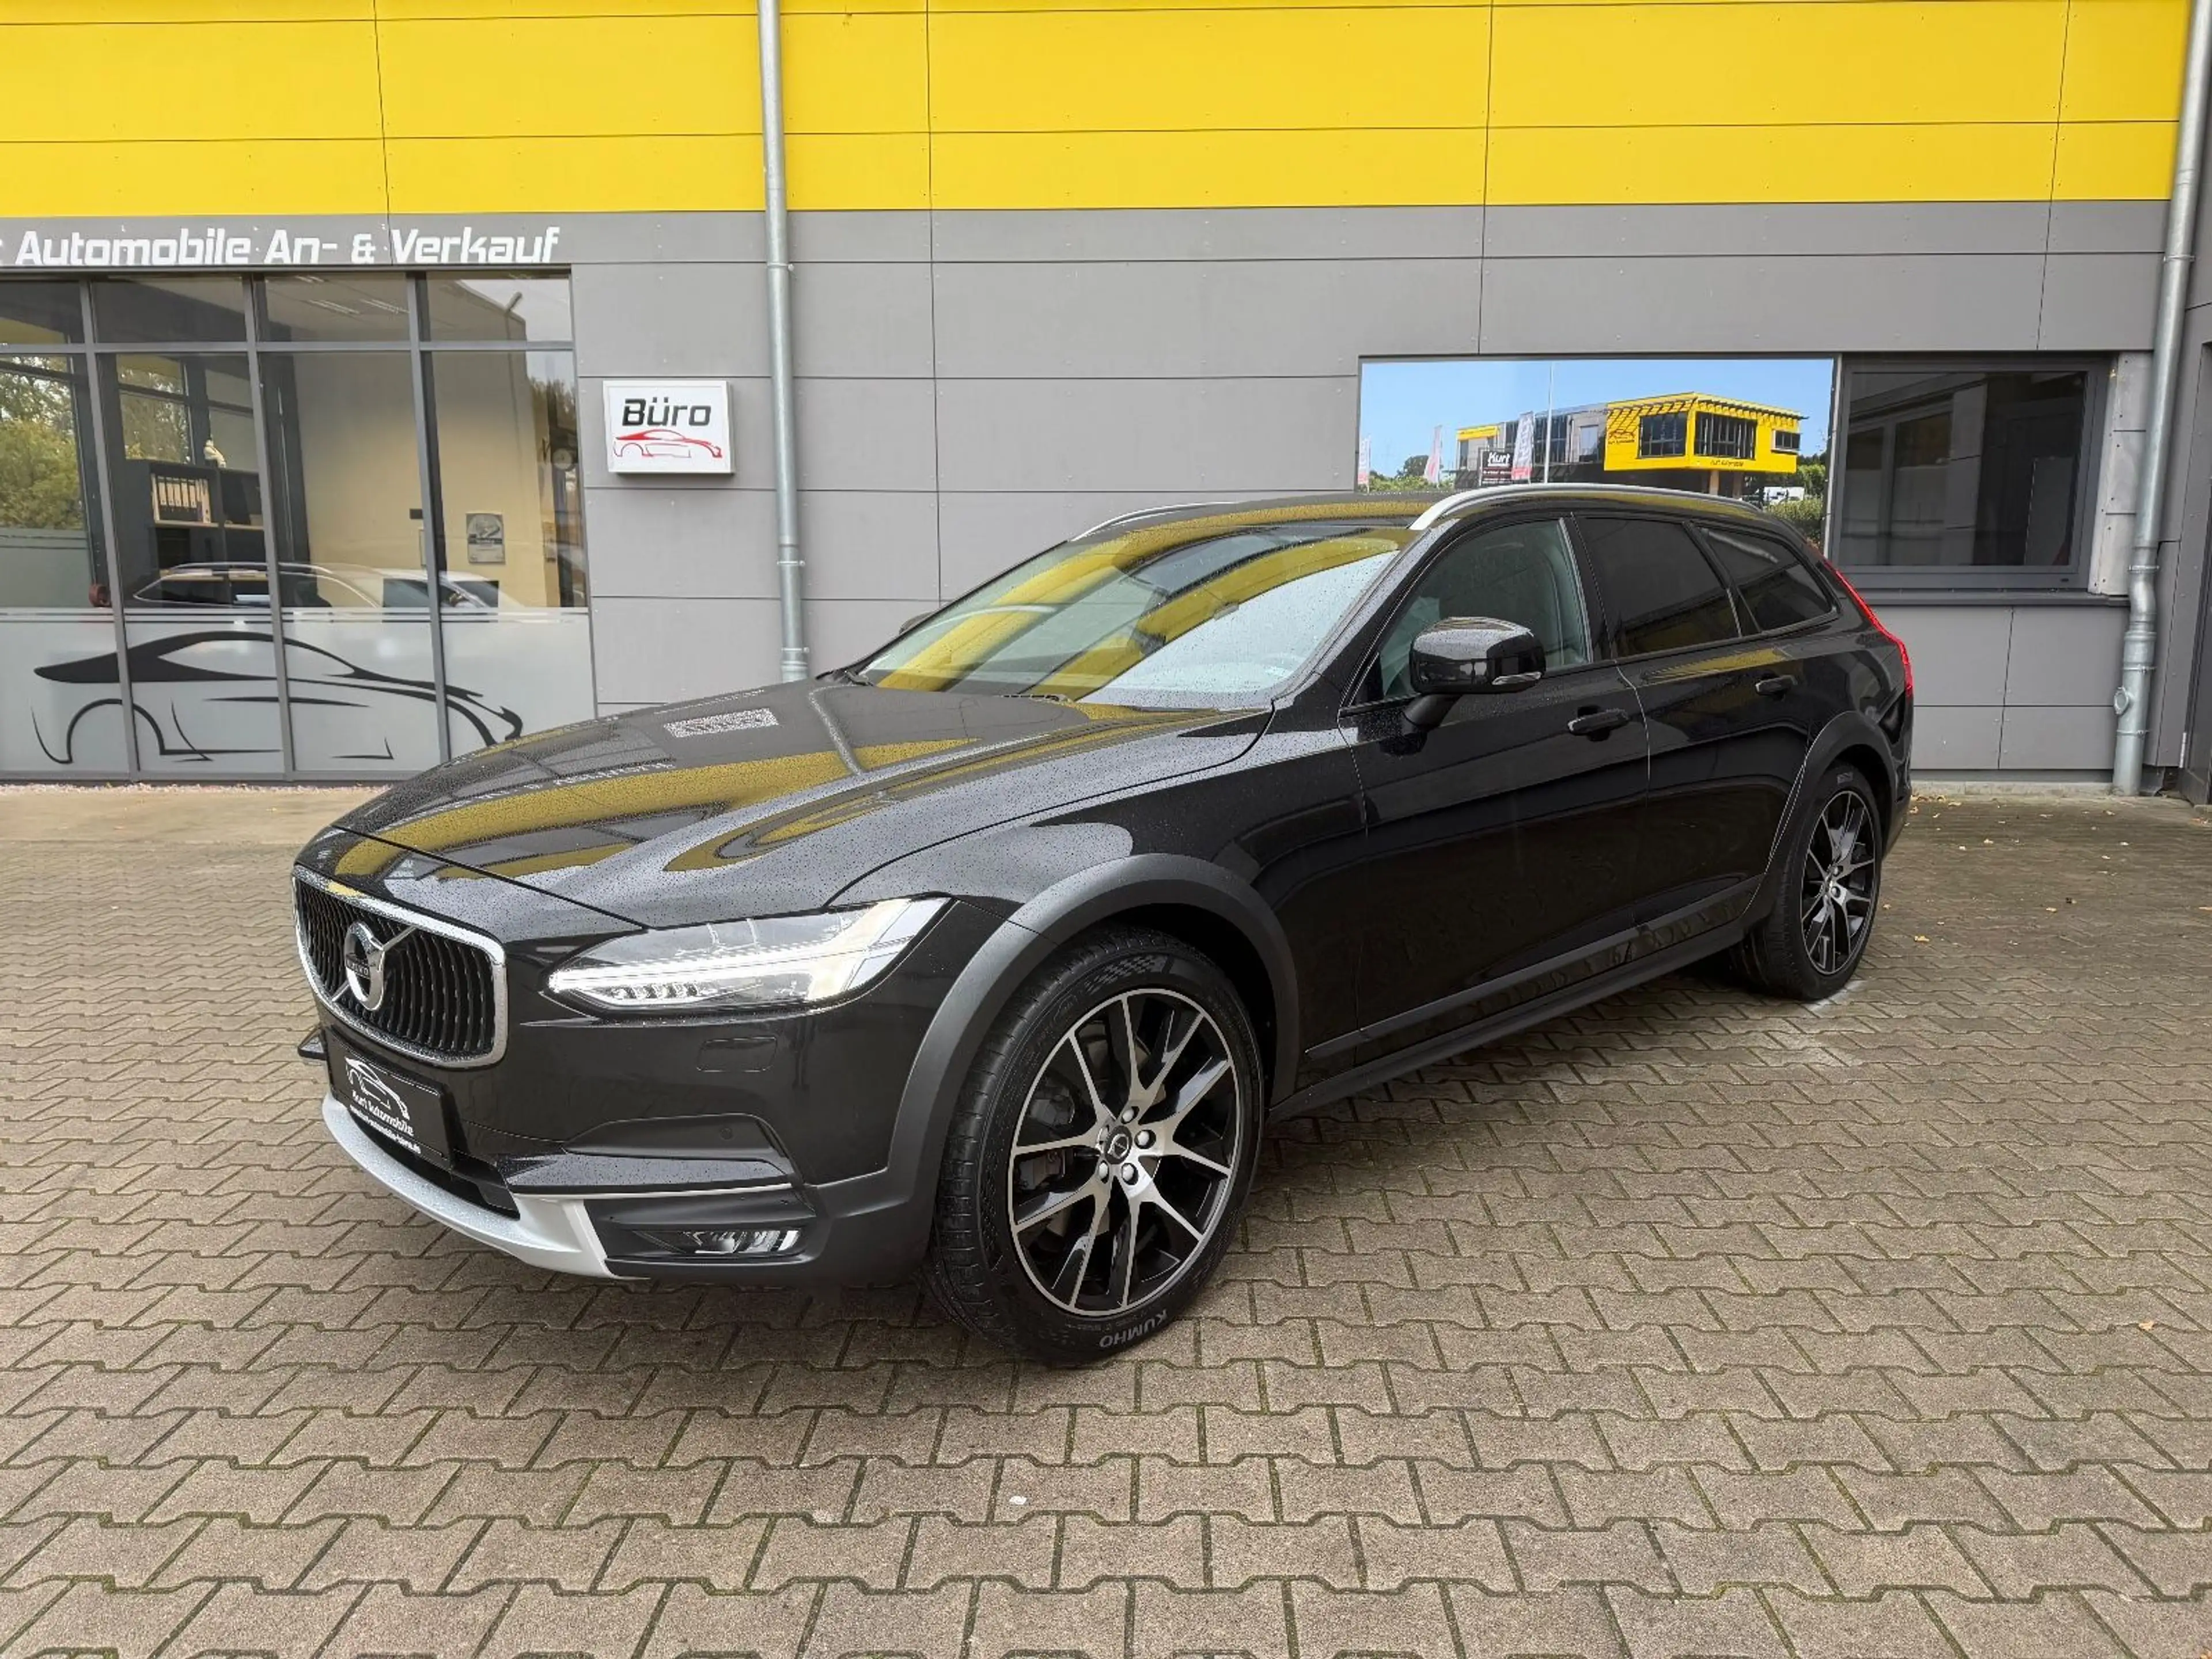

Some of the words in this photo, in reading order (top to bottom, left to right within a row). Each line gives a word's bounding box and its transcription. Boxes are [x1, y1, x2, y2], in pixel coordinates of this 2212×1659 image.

[15, 228, 251, 265] Automobile
[263, 229, 338, 264] An-
[351, 233, 376, 264] &
[391, 227, 560, 263] Verkauf
[622, 396, 711, 426] Büro
[1487, 452, 1510, 464] Kurt
[1099, 1308, 1168, 1348] KUMHO
